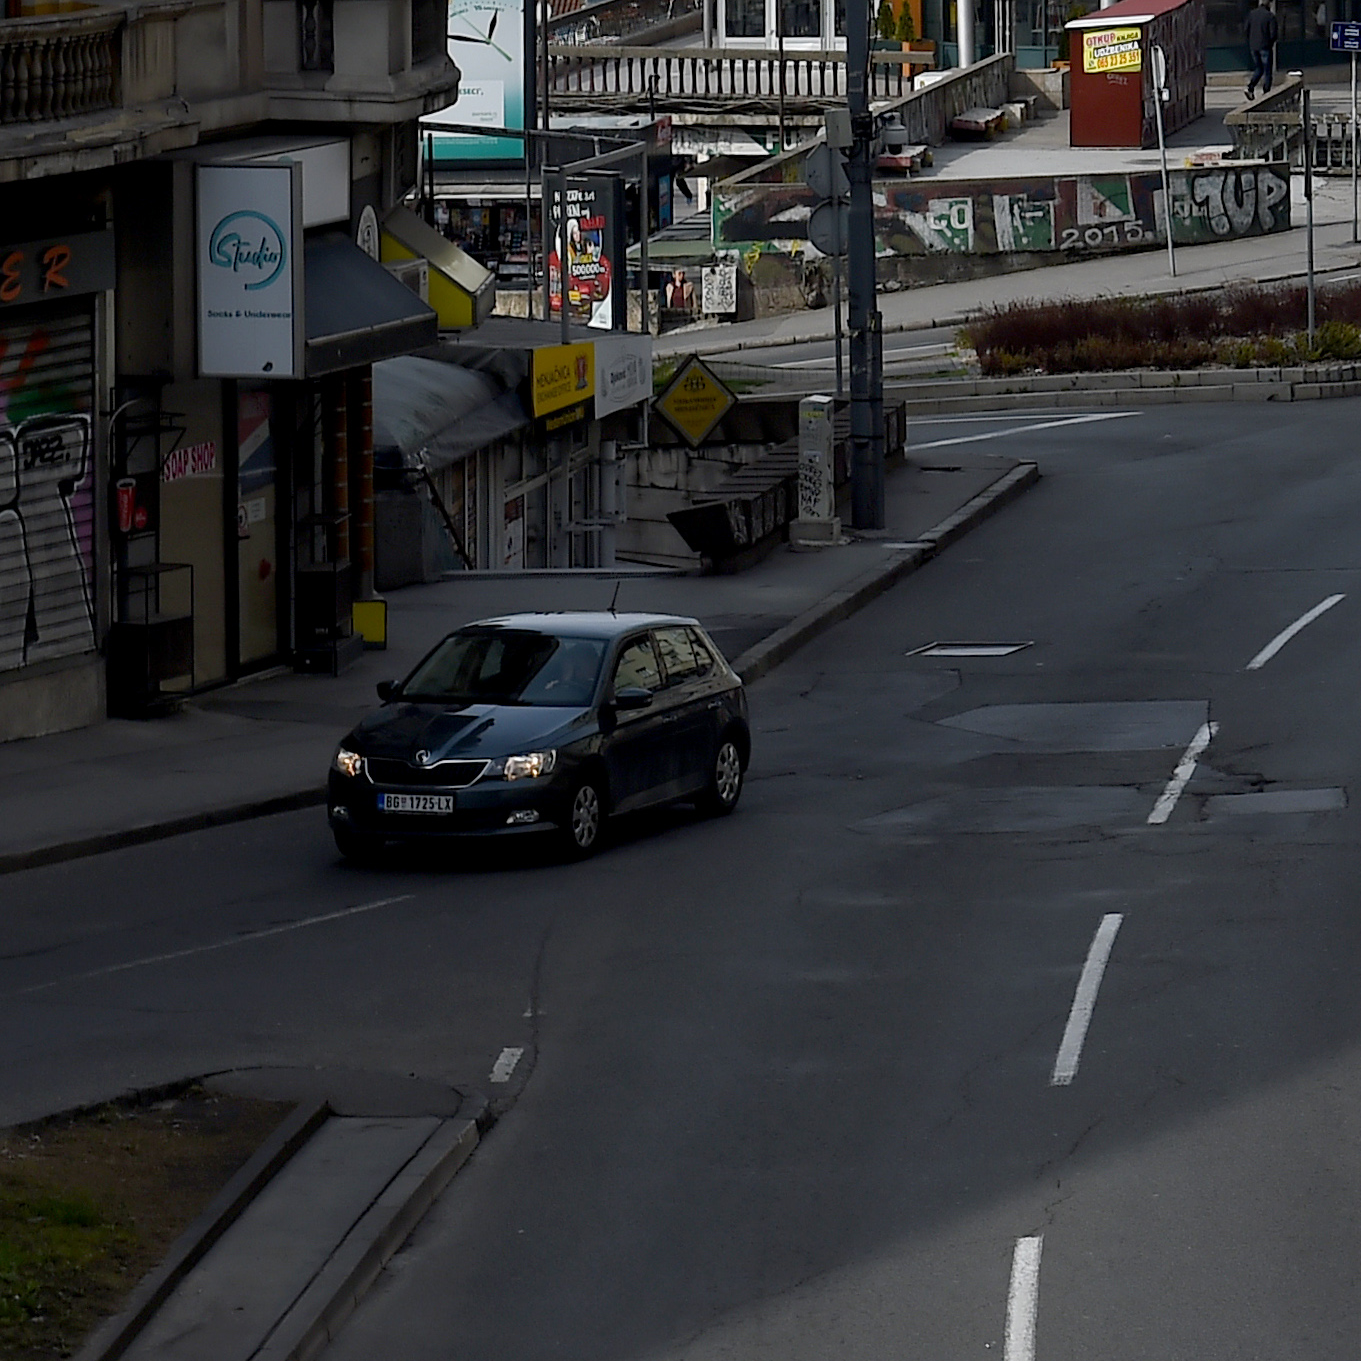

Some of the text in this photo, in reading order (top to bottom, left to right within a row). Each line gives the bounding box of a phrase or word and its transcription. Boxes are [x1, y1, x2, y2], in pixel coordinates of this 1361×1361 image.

[1086, 33, 1116, 47] OTKUP
[212, 233, 281, 273] Studio
[207, 309, 233, 318] Socks
[164, 441, 217, 482] SOAP SHOP
[386, 795, 400, 808] BG
